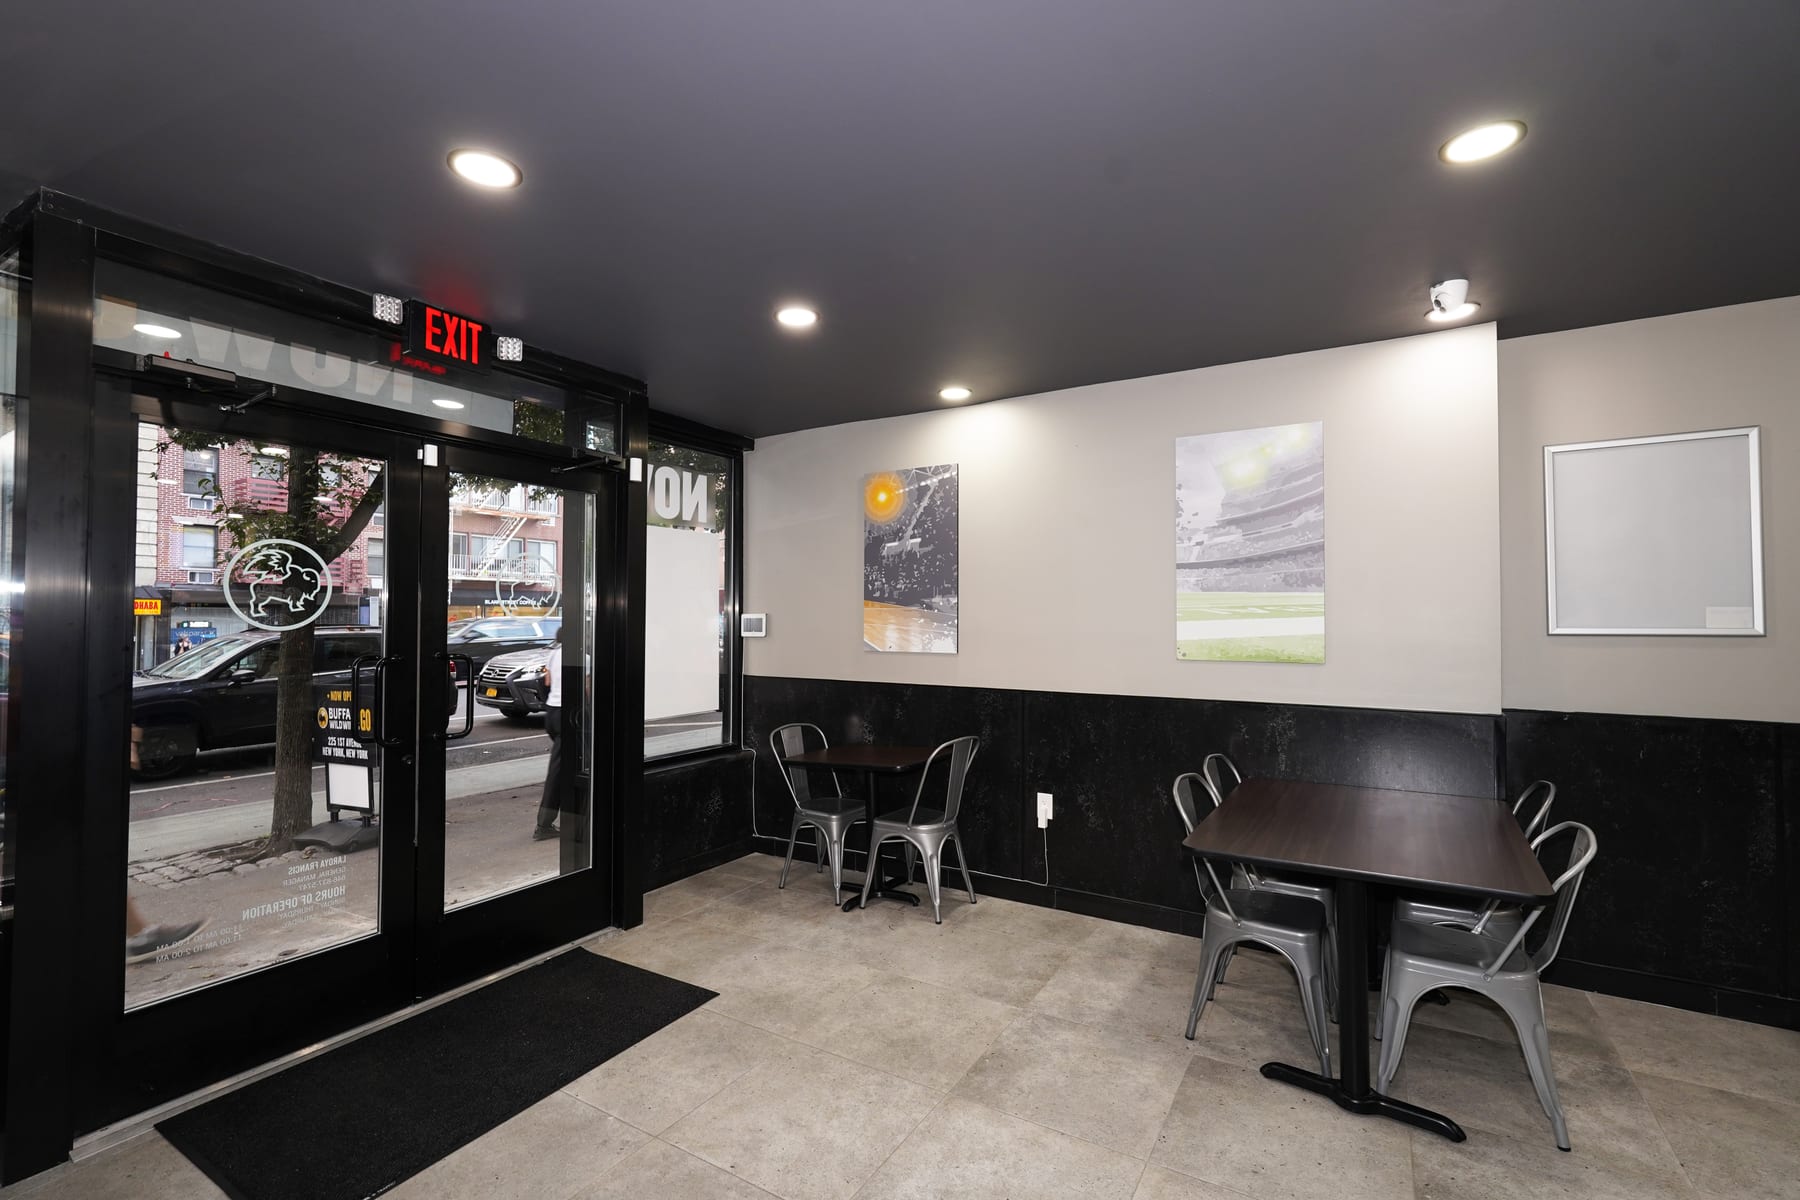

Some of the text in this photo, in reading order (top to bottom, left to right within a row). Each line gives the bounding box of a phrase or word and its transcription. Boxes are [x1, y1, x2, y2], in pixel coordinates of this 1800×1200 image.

[425, 306, 482, 365] EXIT
[134, 601, 158, 610] DHABA
[330, 690, 352, 702] NOW OP
[328, 707, 352, 720] BUFFA
[360, 708, 371, 732] GO
[329, 720, 342, 729] WILD
[328, 736, 336, 746] 225
[337, 737, 345, 747] 1ST
[322, 746, 369, 760] NEW YORK, NEW YORK
